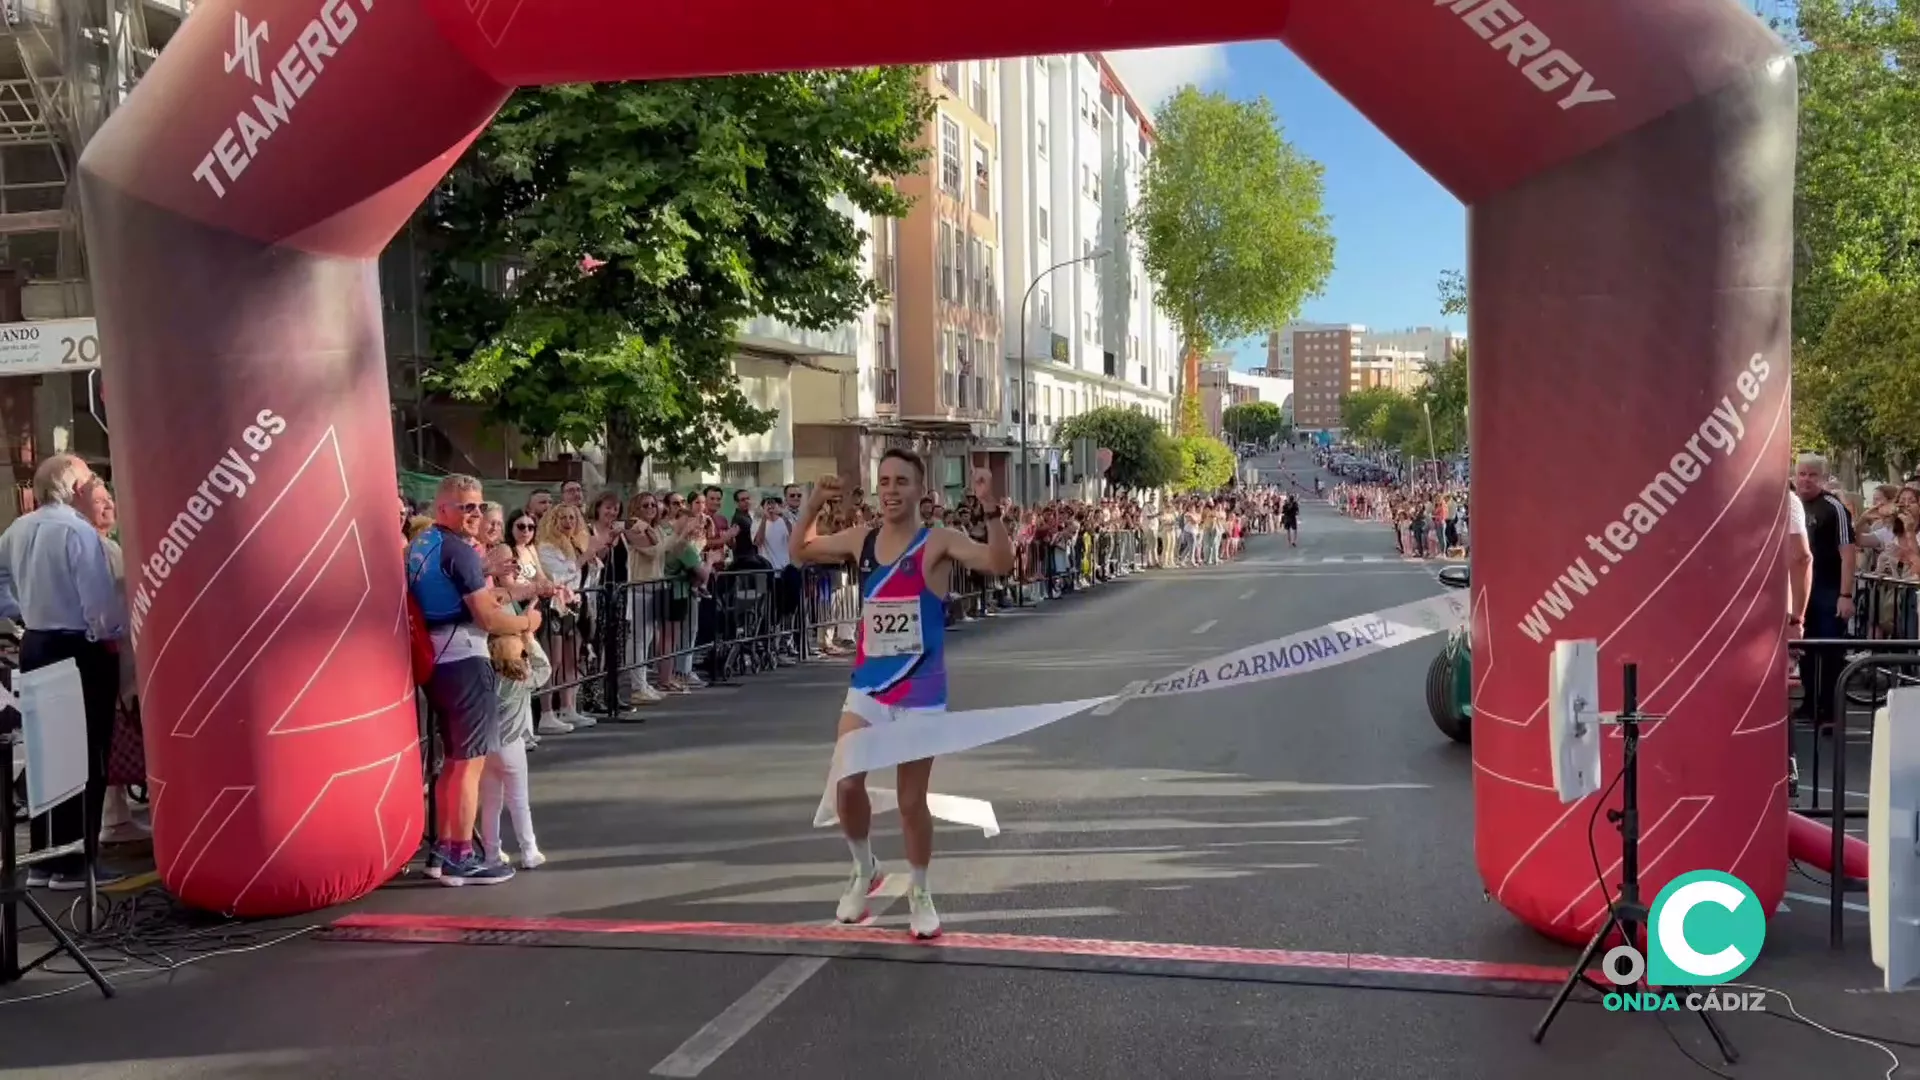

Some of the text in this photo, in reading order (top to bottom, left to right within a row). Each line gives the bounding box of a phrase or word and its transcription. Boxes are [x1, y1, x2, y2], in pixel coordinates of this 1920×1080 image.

[1433, 0, 1616, 110] ERGY
[192, 0, 373, 199] TEAMERG
[0, 327, 40, 341] ANDO
[60, 335, 99, 364] 20
[1517, 352, 1770, 644] www.teamergy.es
[872, 613, 909, 634] 322
[1217, 635, 1338, 681] CARMONA
[1336, 619, 1396, 653] PÁEZ
